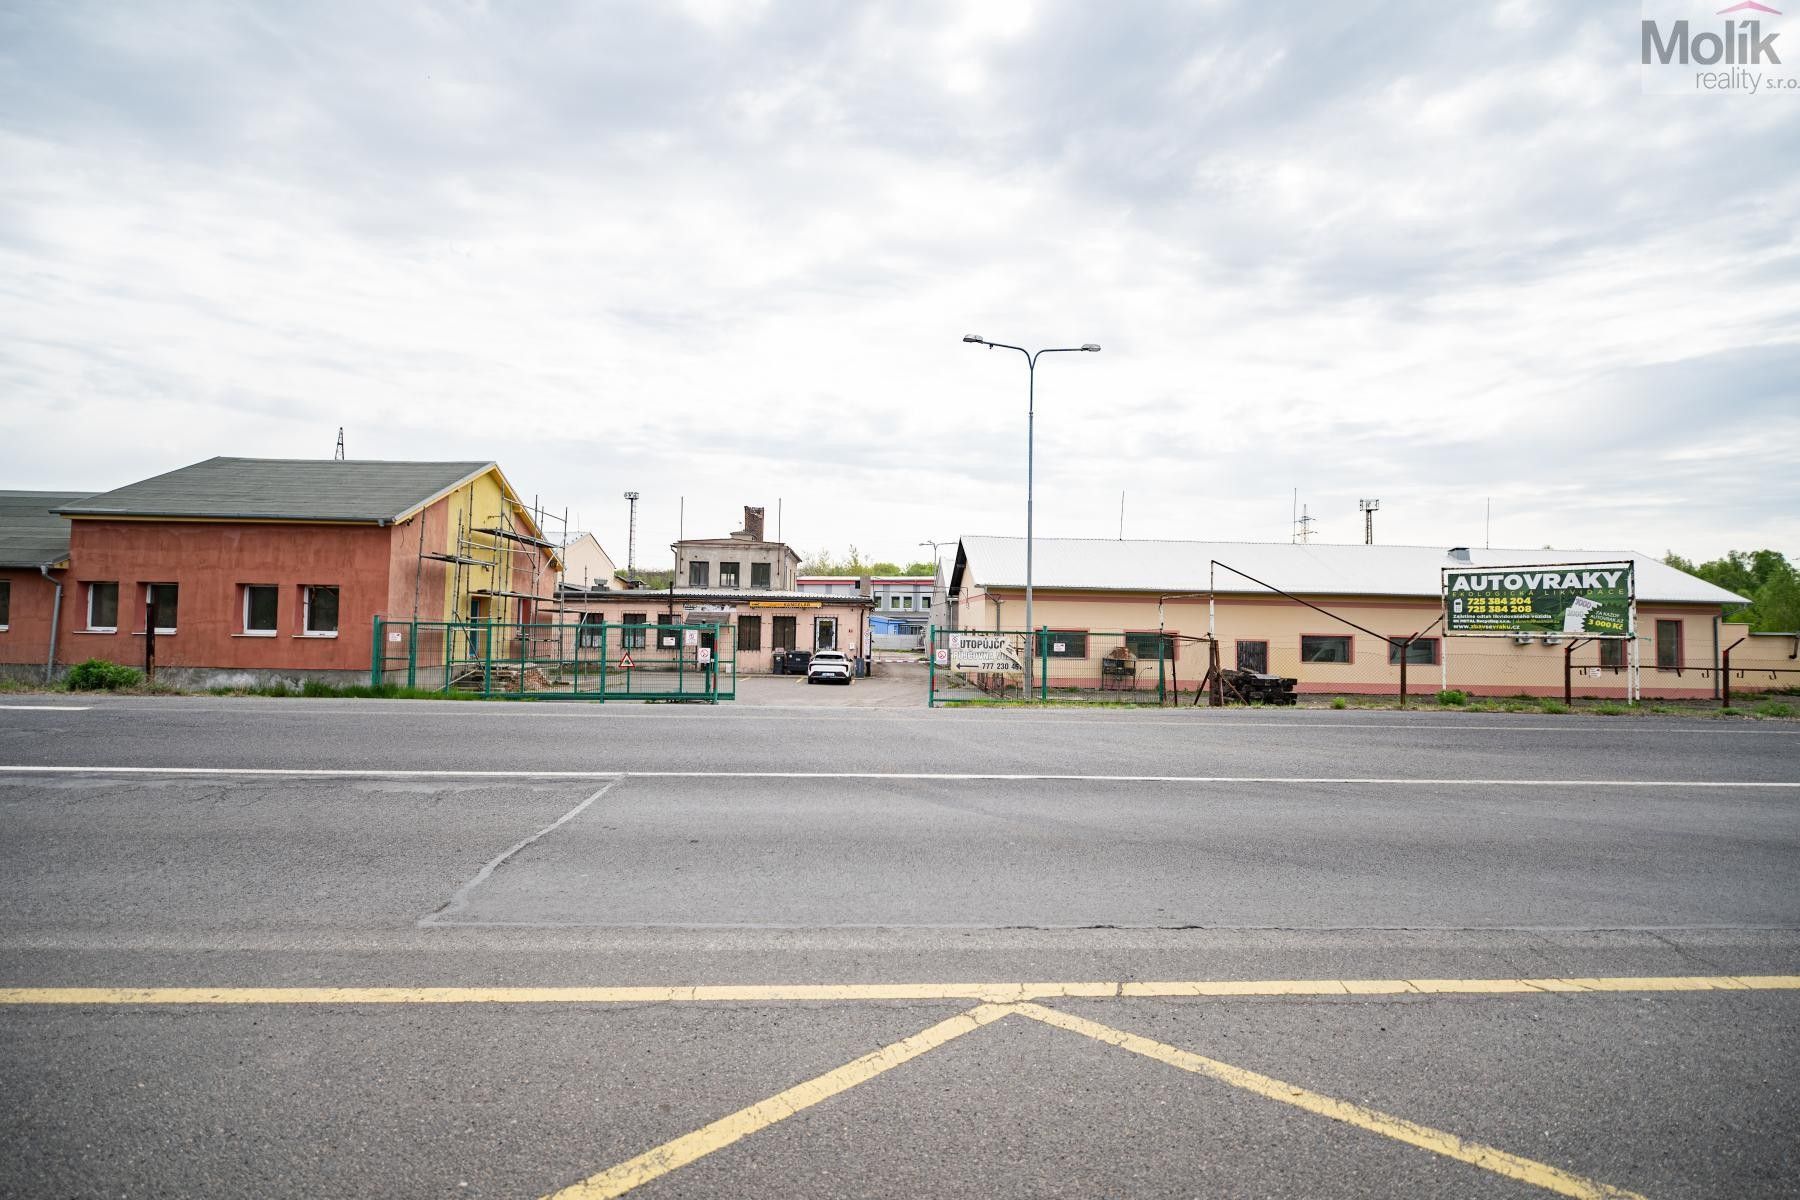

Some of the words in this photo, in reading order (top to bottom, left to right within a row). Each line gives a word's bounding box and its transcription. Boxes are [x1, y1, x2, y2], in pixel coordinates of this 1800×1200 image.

[1452, 571, 1623, 592] AUTOVRAKY
[1452, 589, 1534, 598] EKOLOGICKÁ
[1544, 588, 1624, 596] LIKVIDACE
[1467, 597, 1486, 606] 725
[1488, 597, 1508, 605] 384
[1510, 596, 1532, 605] 204
[1467, 605, 1486, 613] 725
[1488, 605, 1508, 613] 384
[1510, 605, 1532, 613] 208
[1595, 619, 1612, 628] 000
[982, 662, 994, 670] 777
[996, 662, 1009, 670] 230
